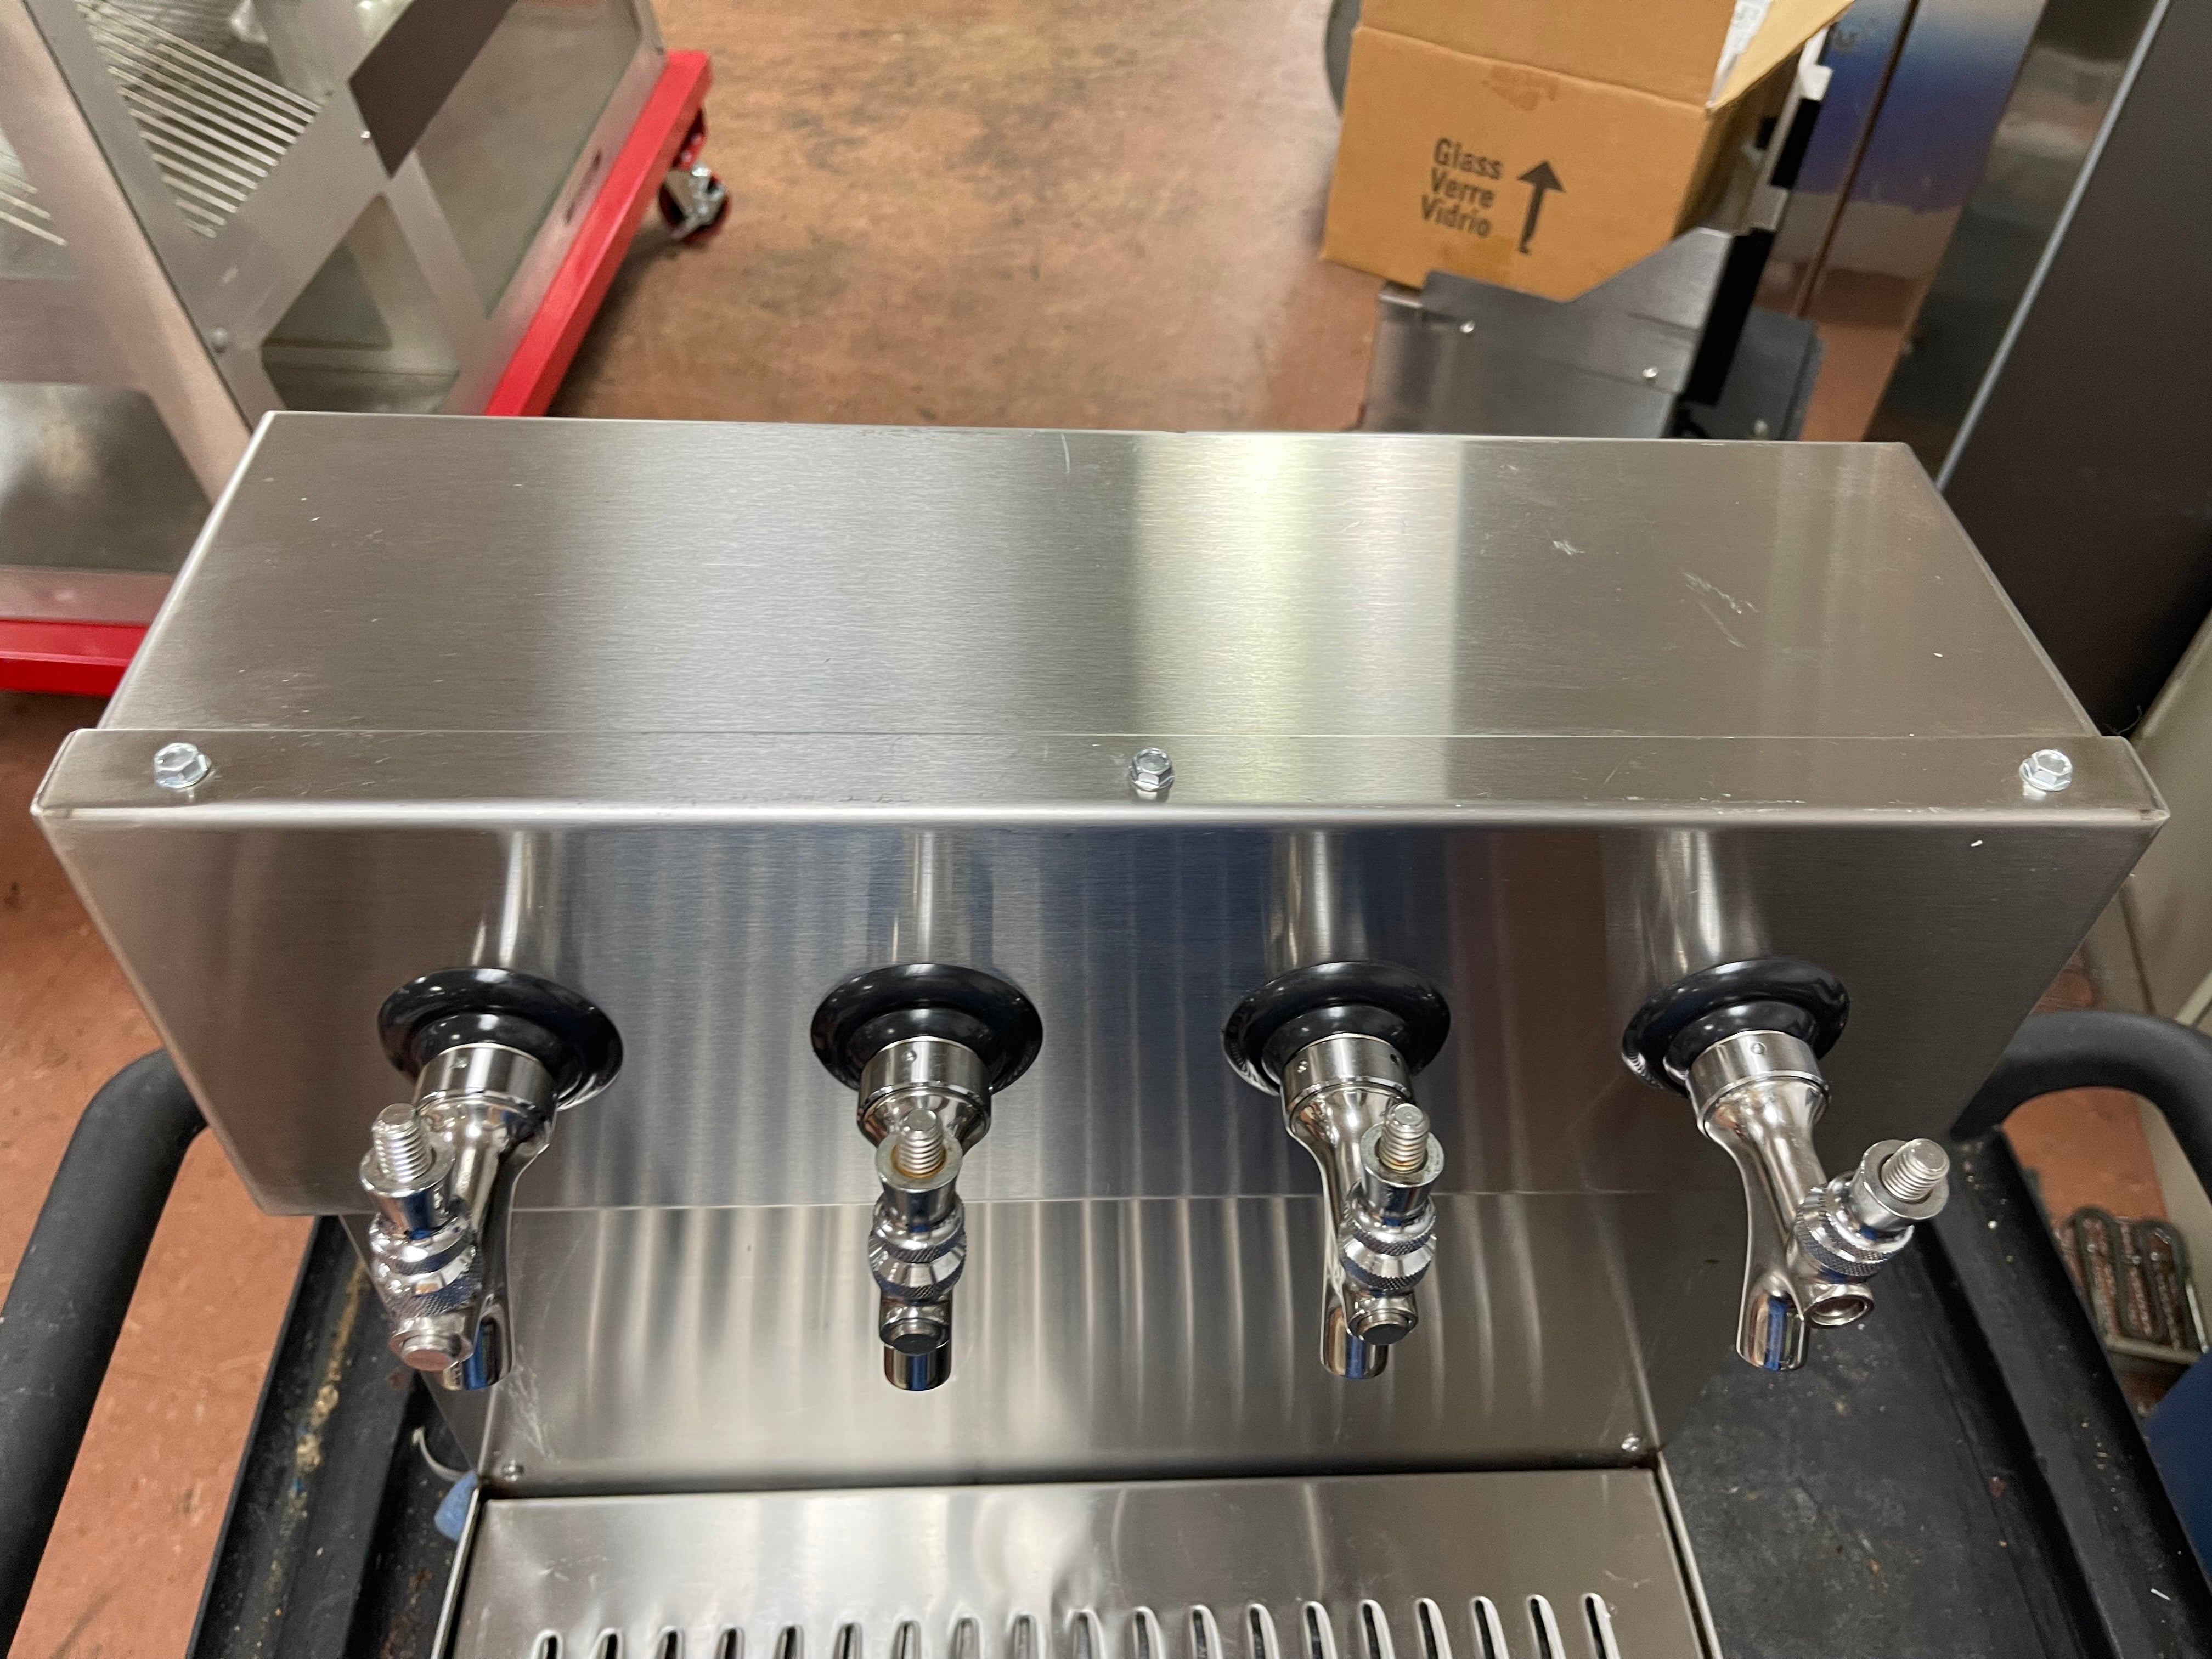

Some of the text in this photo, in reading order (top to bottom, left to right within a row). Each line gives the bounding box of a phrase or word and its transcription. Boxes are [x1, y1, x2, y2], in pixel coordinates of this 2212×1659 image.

[1434, 137, 1502, 180] Glass
[1431, 166, 1494, 208] Verre
[1421, 194, 1491, 238] Vidrio
